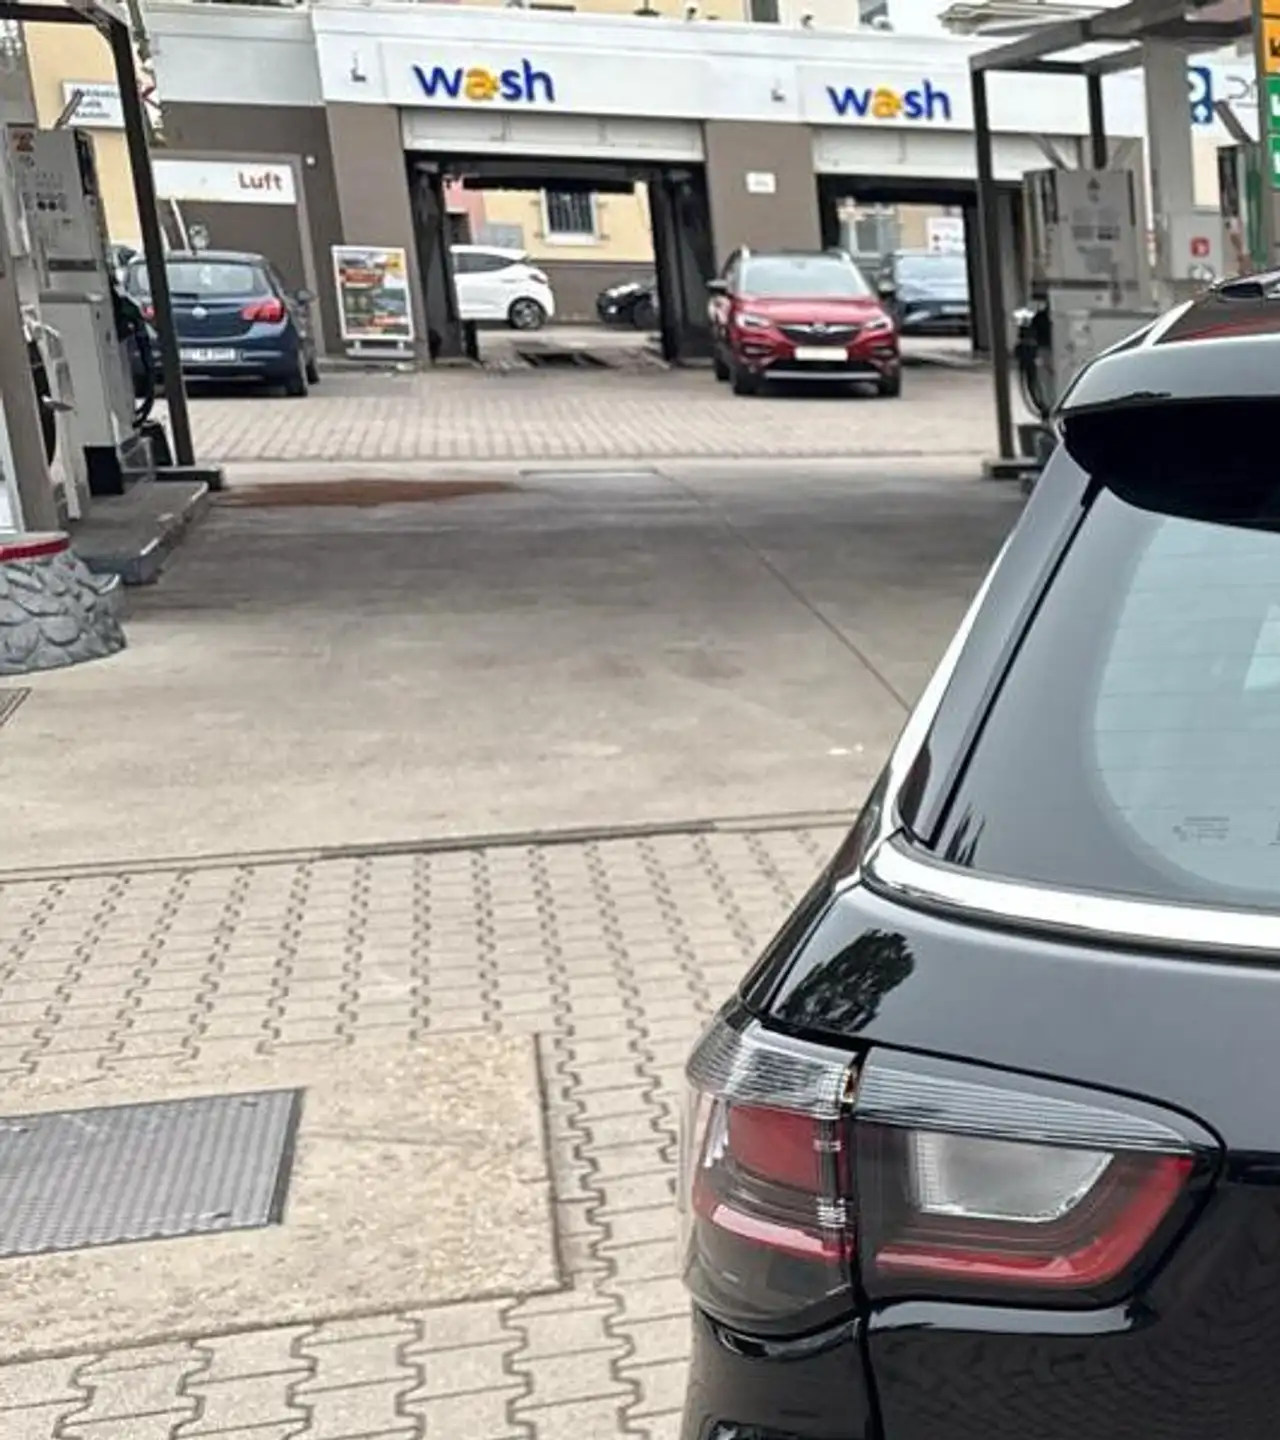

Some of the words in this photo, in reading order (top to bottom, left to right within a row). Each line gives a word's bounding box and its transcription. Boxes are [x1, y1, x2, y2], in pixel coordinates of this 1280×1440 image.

[413, 57, 555, 102] wash
[826, 79, 952, 122] wash
[238, 171, 283, 191] Luft
